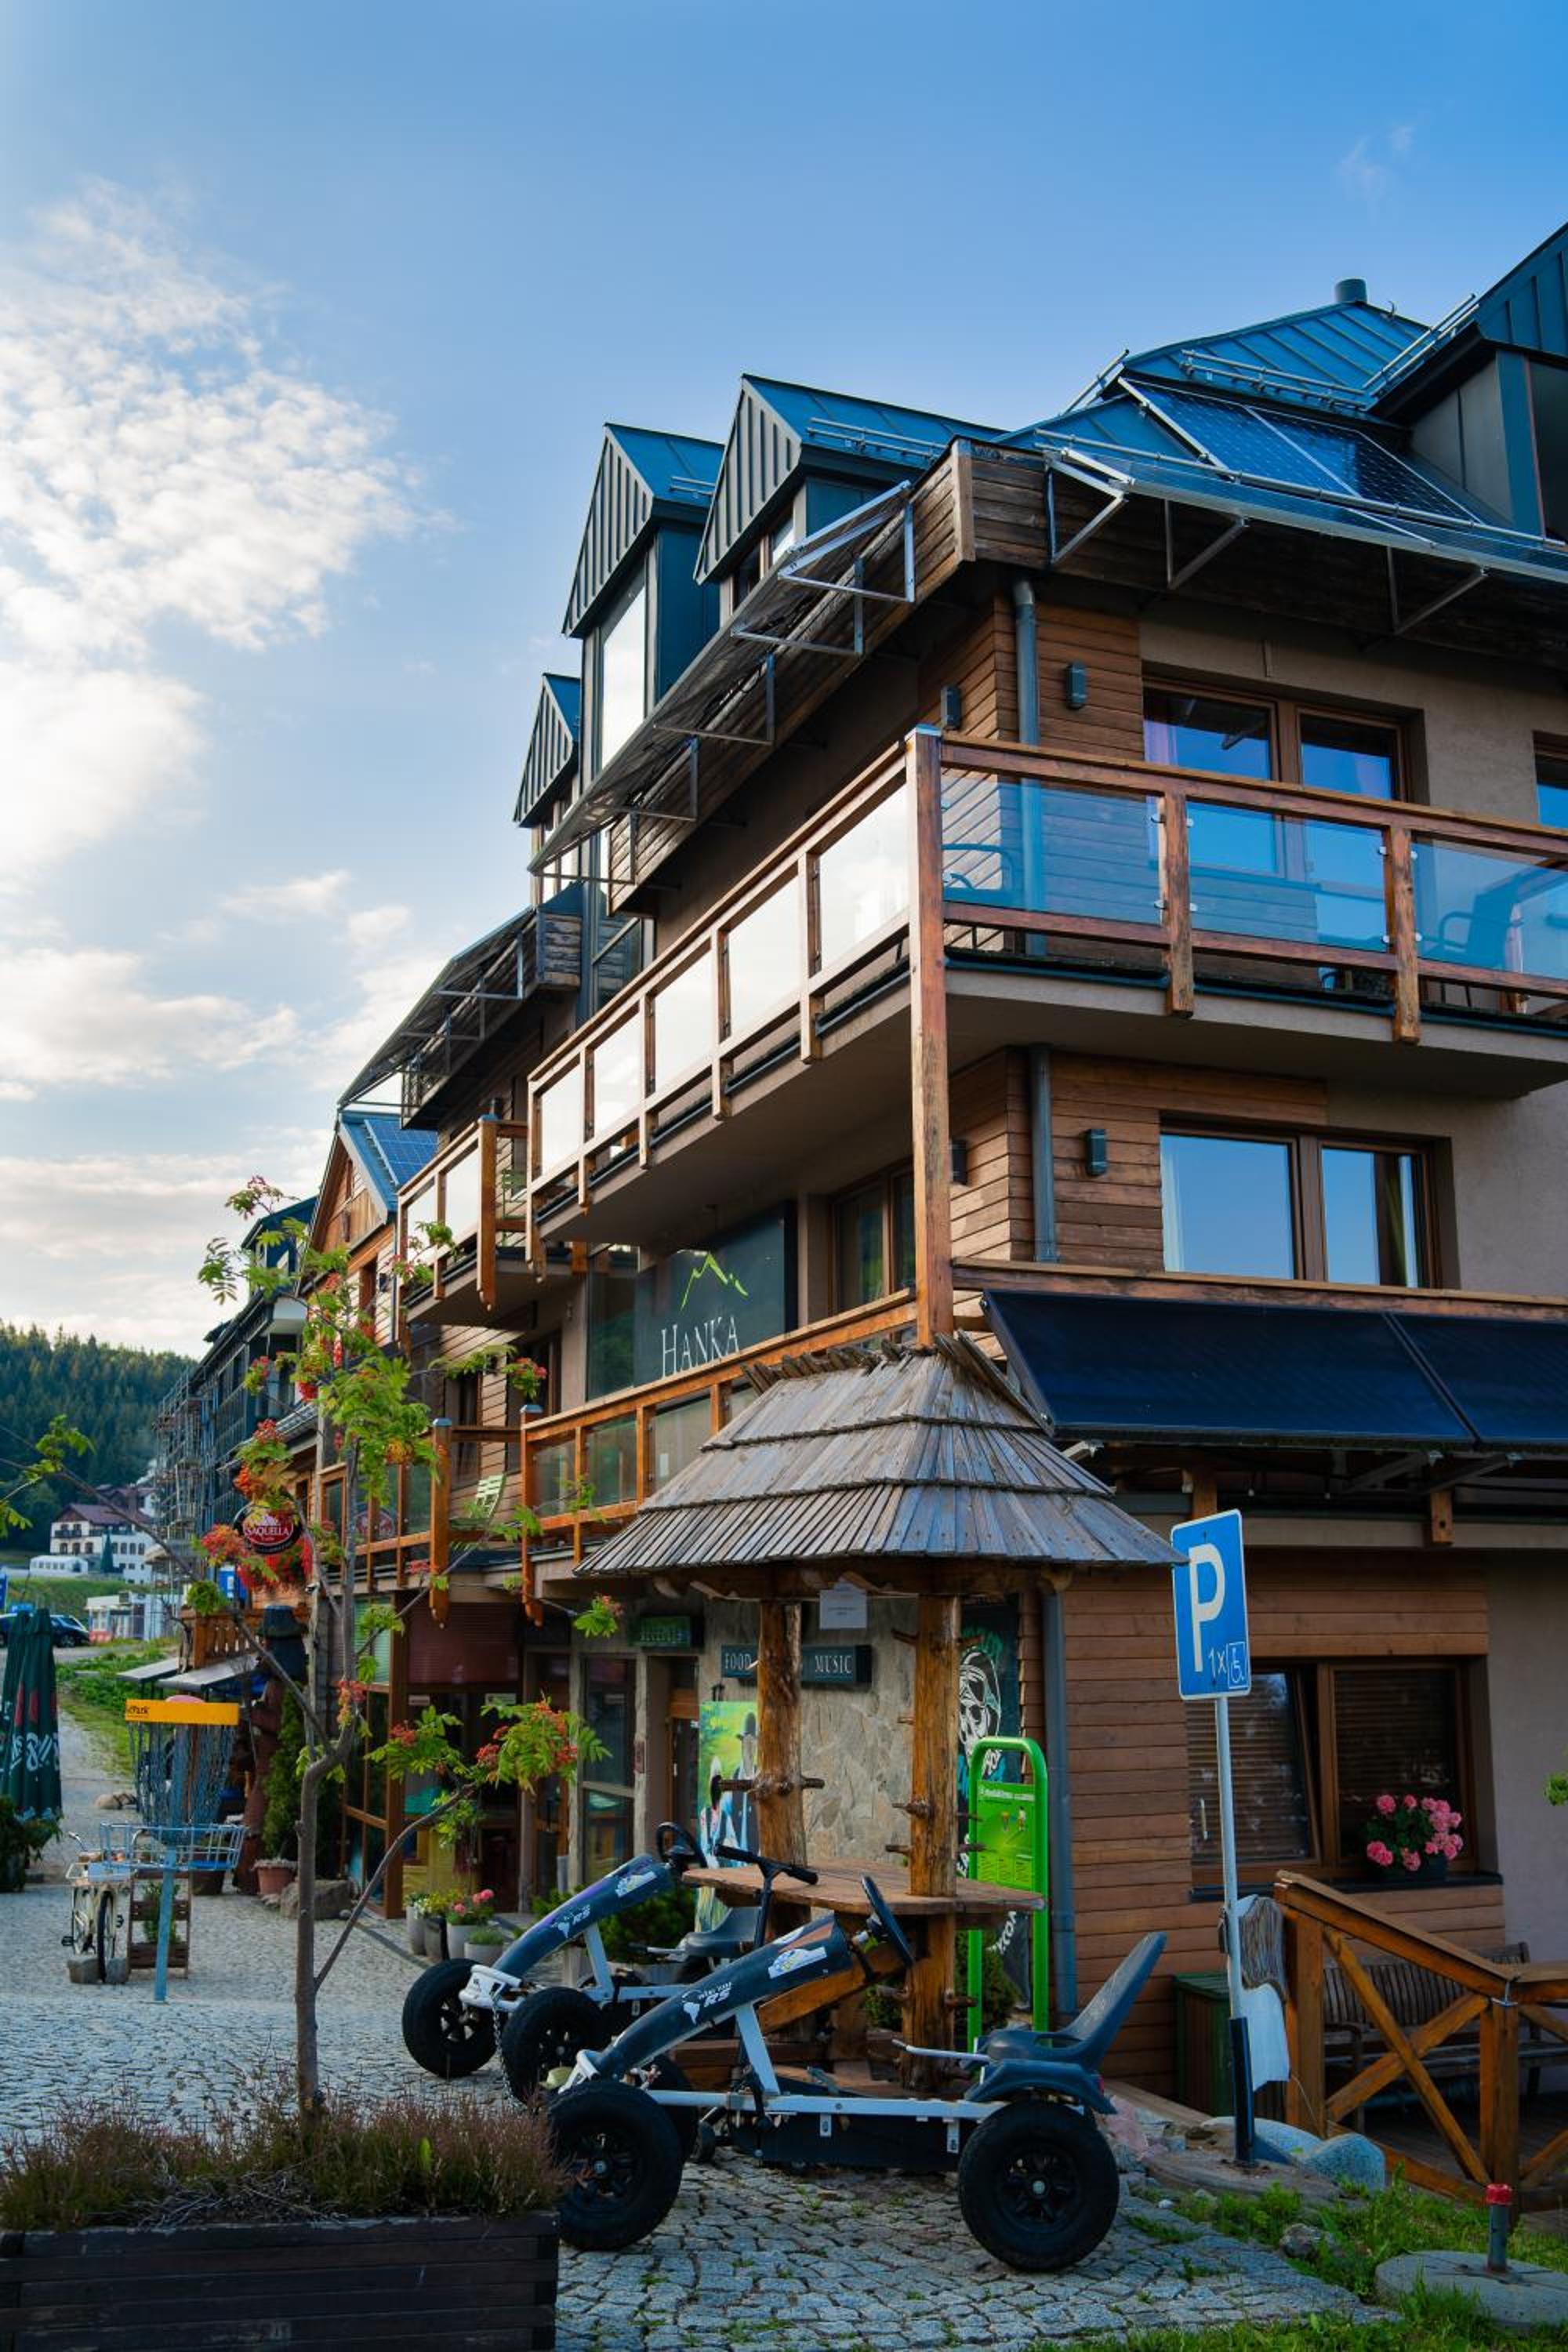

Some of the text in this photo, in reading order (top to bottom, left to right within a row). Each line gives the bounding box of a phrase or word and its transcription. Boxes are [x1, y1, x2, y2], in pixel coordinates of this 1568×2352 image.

[1189, 1543, 1226, 1672] P
[725, 1652, 853, 1674] FOOD MUSIC
[704, 1988, 730, 2008] RS
